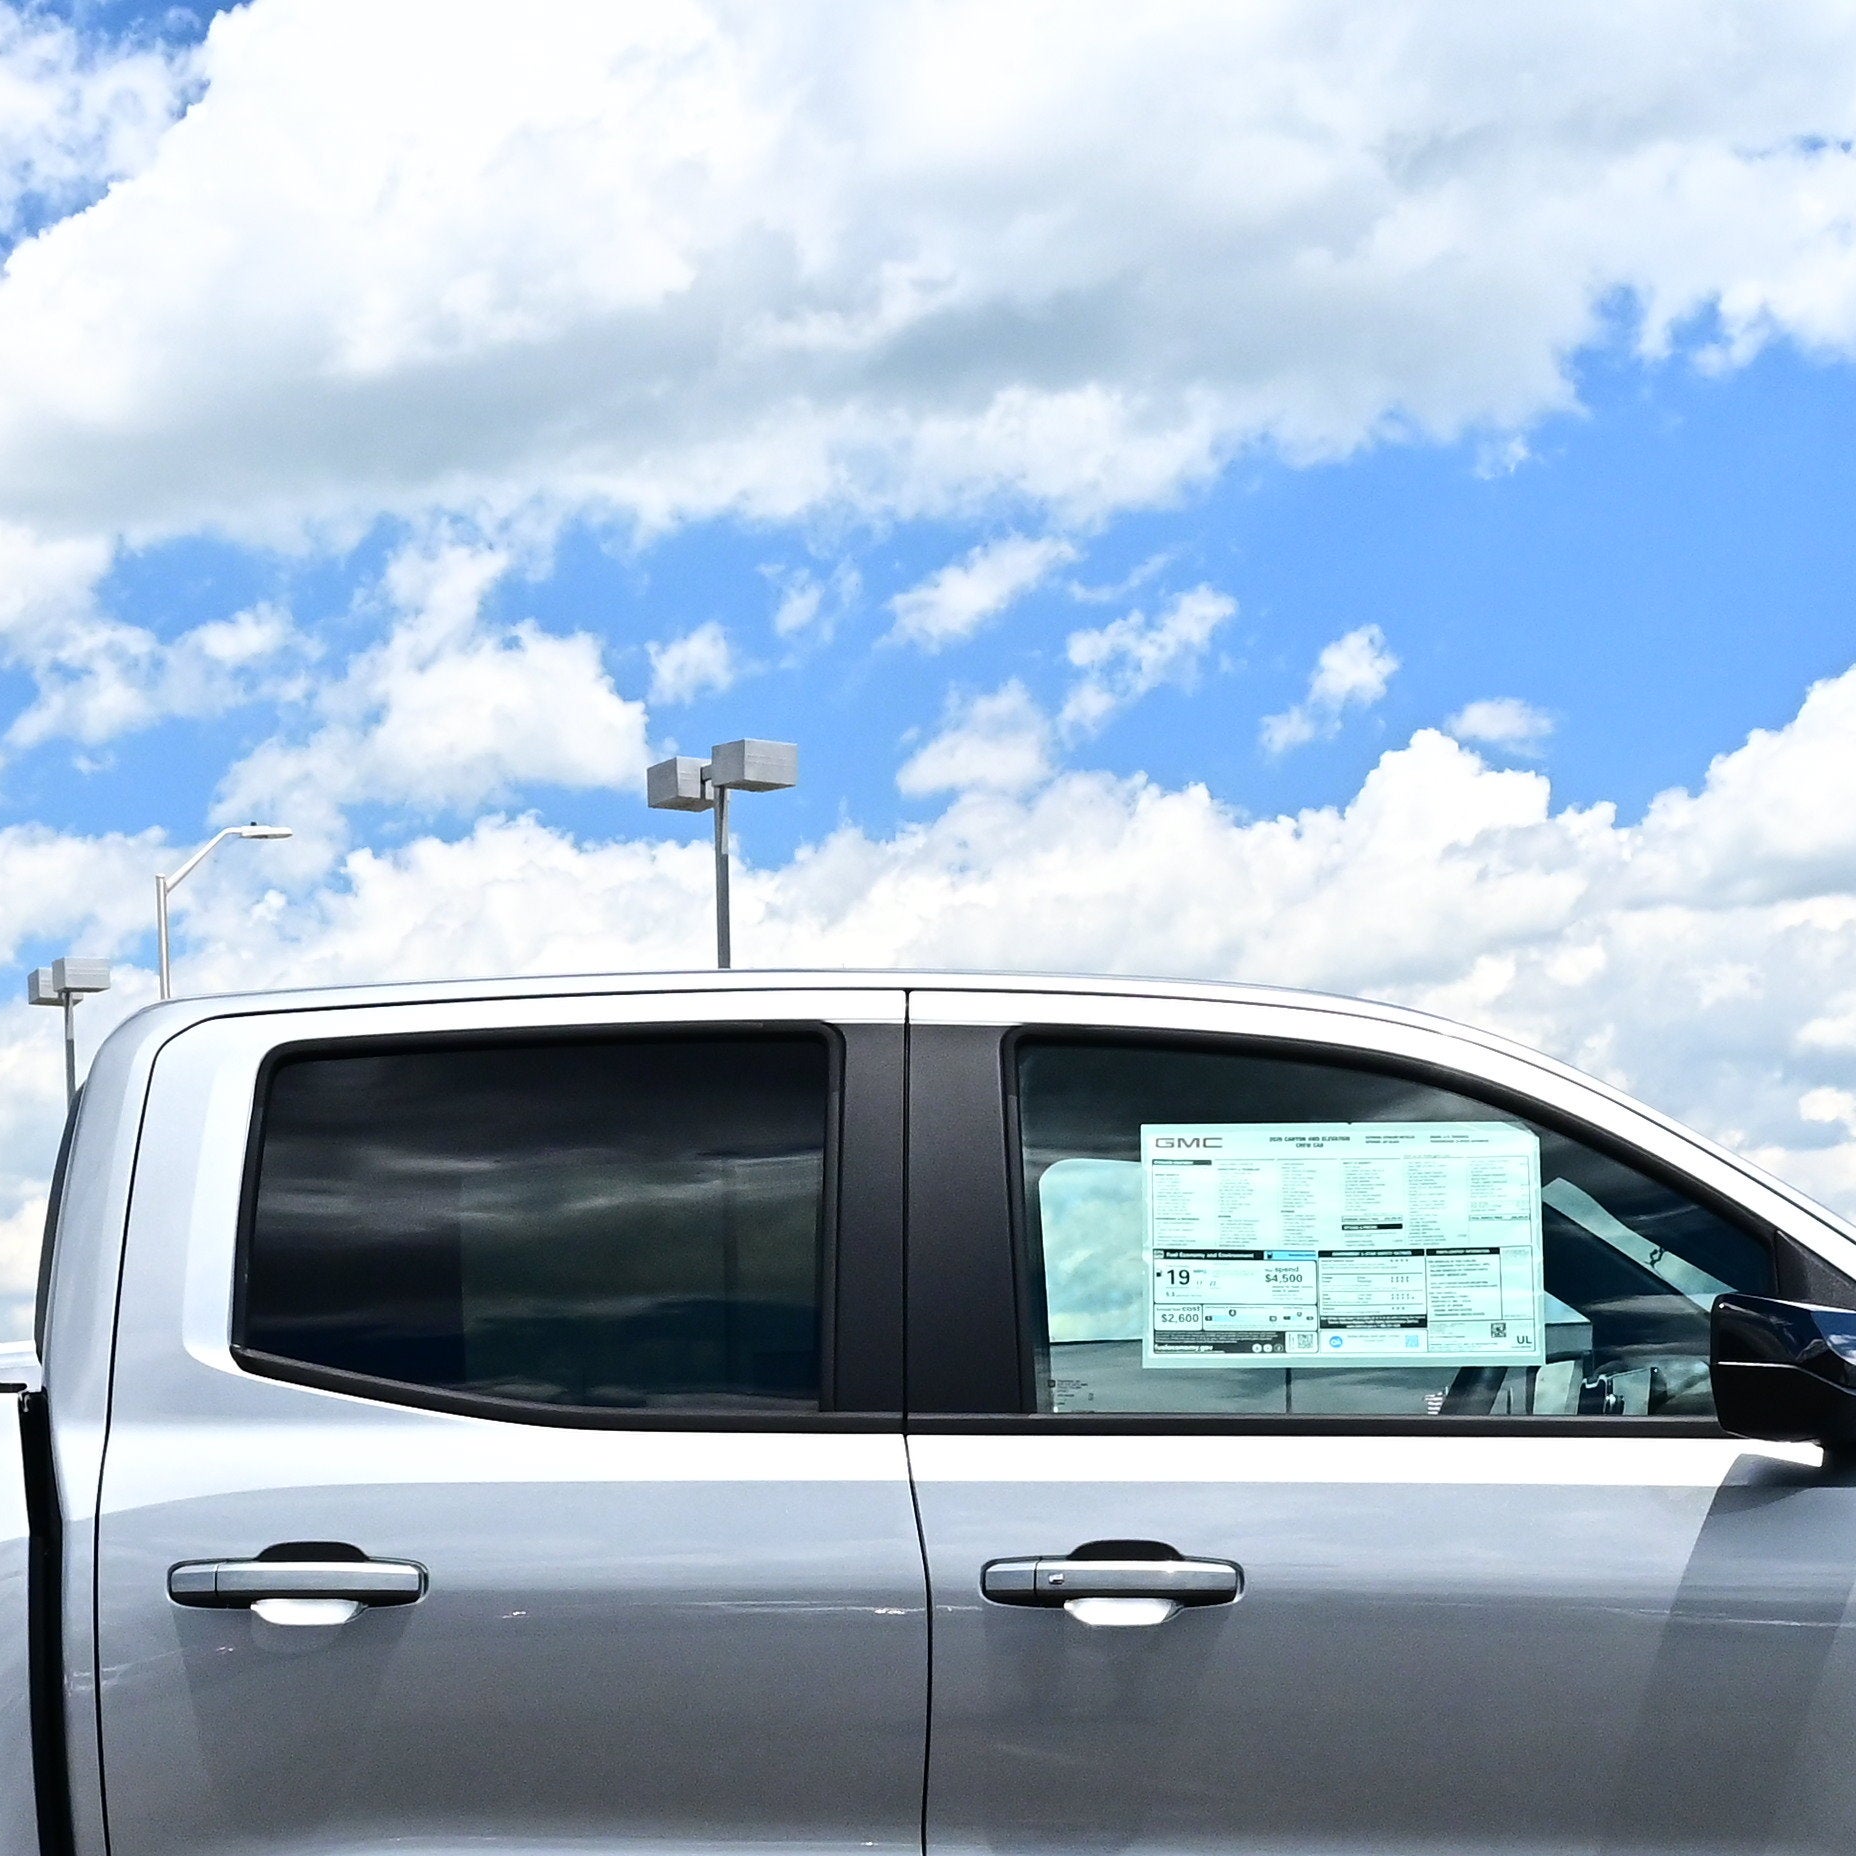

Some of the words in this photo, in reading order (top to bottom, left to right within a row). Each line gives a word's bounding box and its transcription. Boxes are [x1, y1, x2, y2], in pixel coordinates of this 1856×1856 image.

[1155, 1137, 1223, 1148] GMC
[1167, 1269, 1190, 1285] 19
[1265, 1273, 1303, 1284] $4,500
[1161, 1313, 1199, 1323] $2,600
[1517, 1335, 1532, 1345] UL
